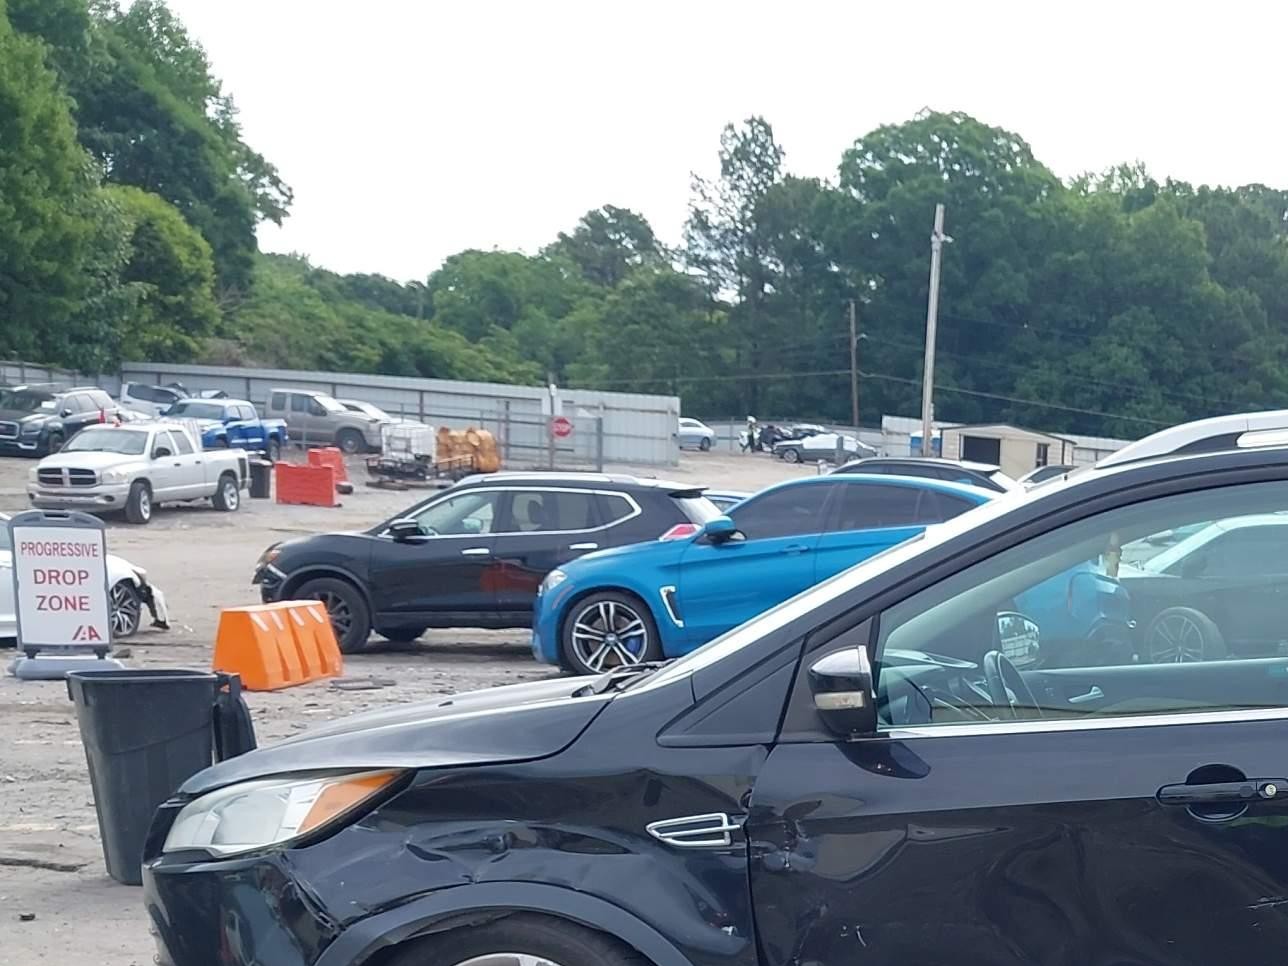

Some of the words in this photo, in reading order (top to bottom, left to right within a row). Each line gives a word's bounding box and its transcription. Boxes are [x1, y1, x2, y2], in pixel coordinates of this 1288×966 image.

[20, 541, 99, 558] PROGRESSIVE
[33, 569, 89, 586] DROP
[35, 595, 91, 611] ZONE
